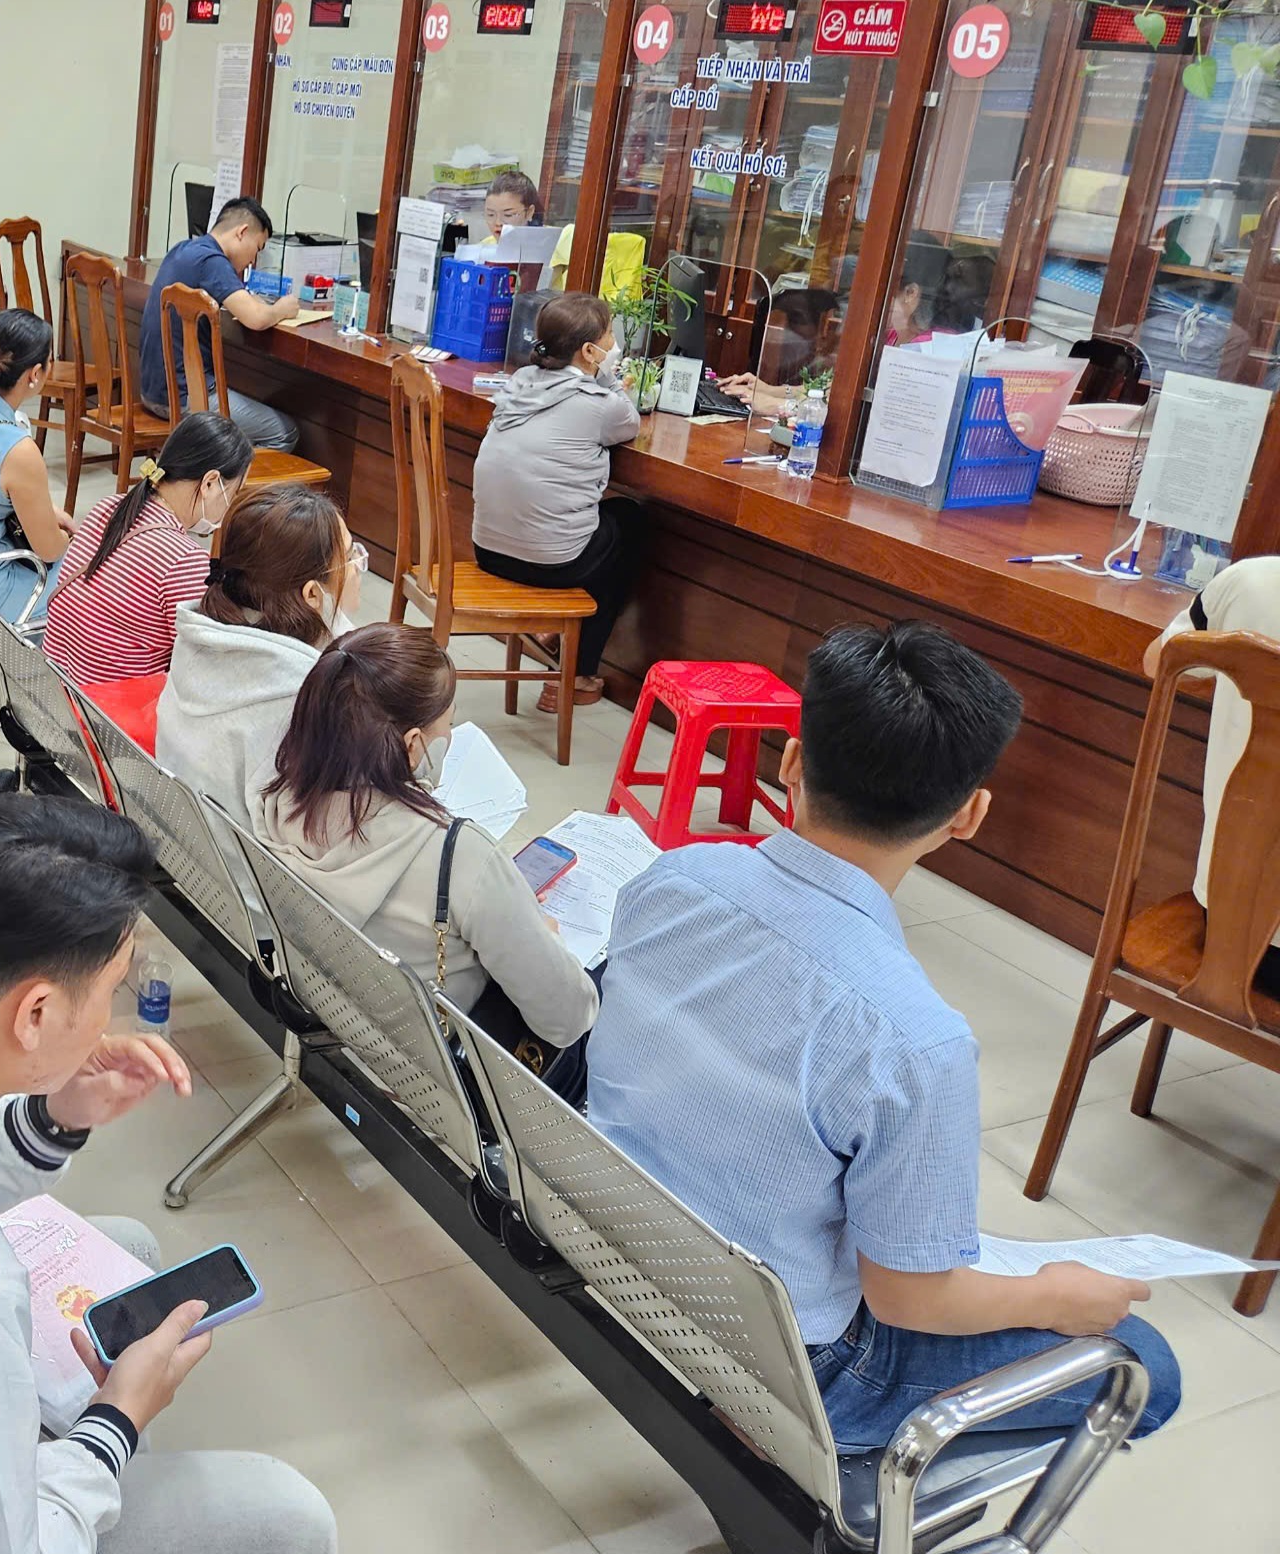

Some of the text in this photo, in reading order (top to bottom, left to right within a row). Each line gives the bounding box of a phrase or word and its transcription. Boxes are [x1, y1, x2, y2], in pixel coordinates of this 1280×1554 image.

[159, 12, 172, 31] 01
[274, 12, 293, 35] 02
[425, 14, 449, 40] 03
[853, 2, 893, 26] CẤM
[636, 19, 669, 49] 04
[843, 27, 898, 47] HÚT THUỐC
[952, 22, 1003, 60] 05
[332, 57, 348, 71] CUNG
[697, 53, 811, 83] TIẾP NHẬN VÀ TRẢ
[671, 83, 719, 110] CẤP ĐỔI
[690, 144, 715, 168] KẾT
[716, 147, 742, 172] QUẢ
[763, 155, 787, 177] SƠ:
